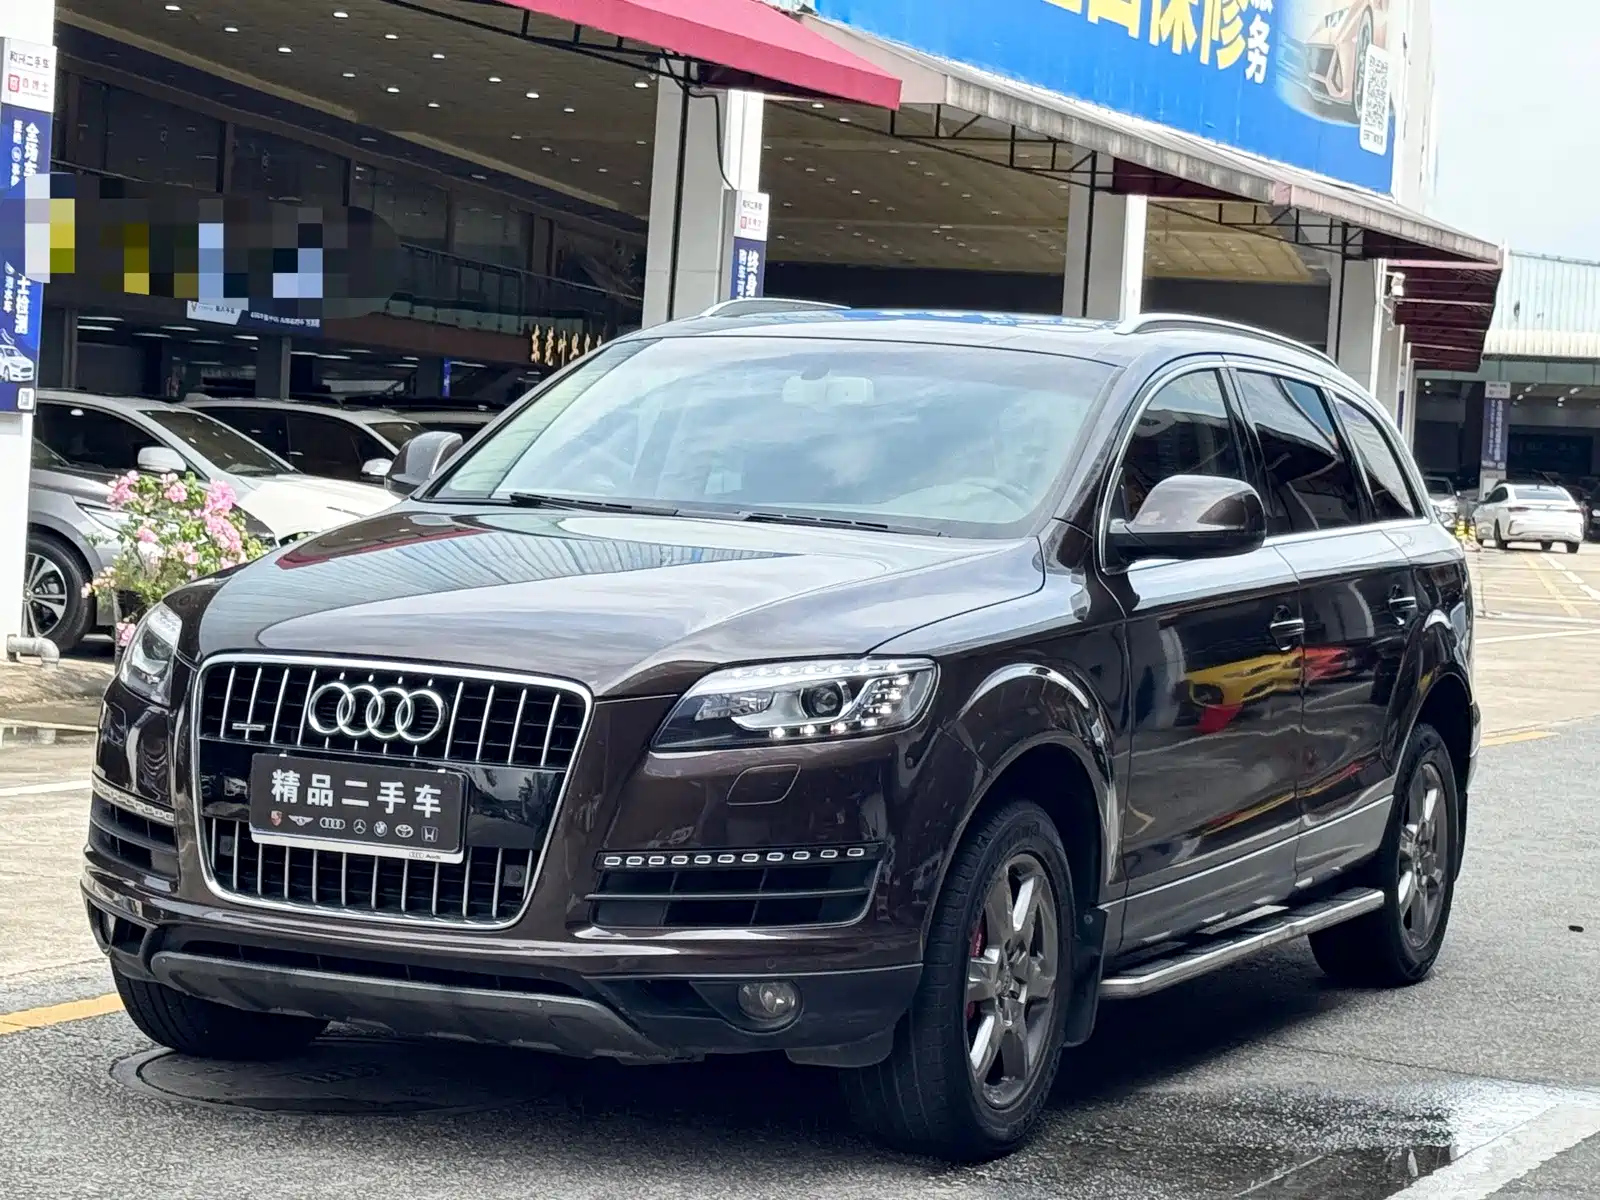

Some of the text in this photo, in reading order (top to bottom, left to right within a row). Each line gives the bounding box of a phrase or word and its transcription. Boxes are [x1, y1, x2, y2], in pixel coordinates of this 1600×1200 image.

[1243, 0, 1273, 84] 务
[271, 769, 442, 819] 精品二手车
